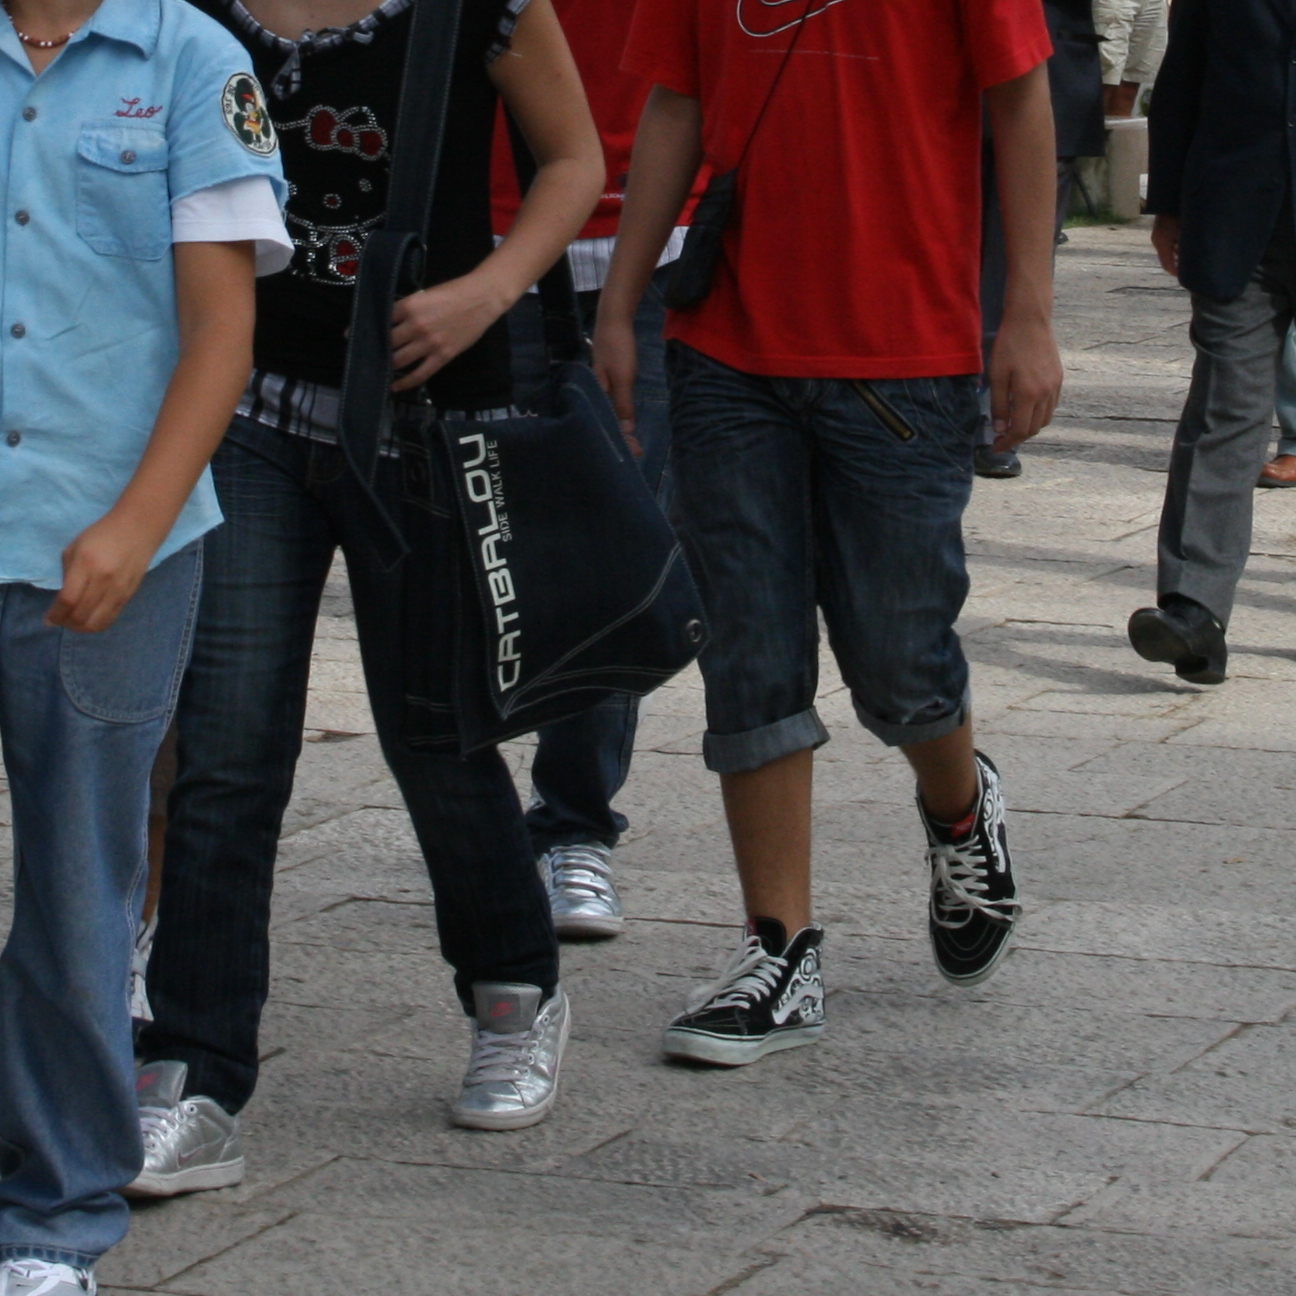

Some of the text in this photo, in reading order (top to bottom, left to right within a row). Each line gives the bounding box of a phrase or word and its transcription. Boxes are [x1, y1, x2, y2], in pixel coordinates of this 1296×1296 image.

[114, 97, 163, 119] Leo
[486, 439, 513, 542] SIDE WALK LIFE
[459, 433, 522, 692] CATBALOU
